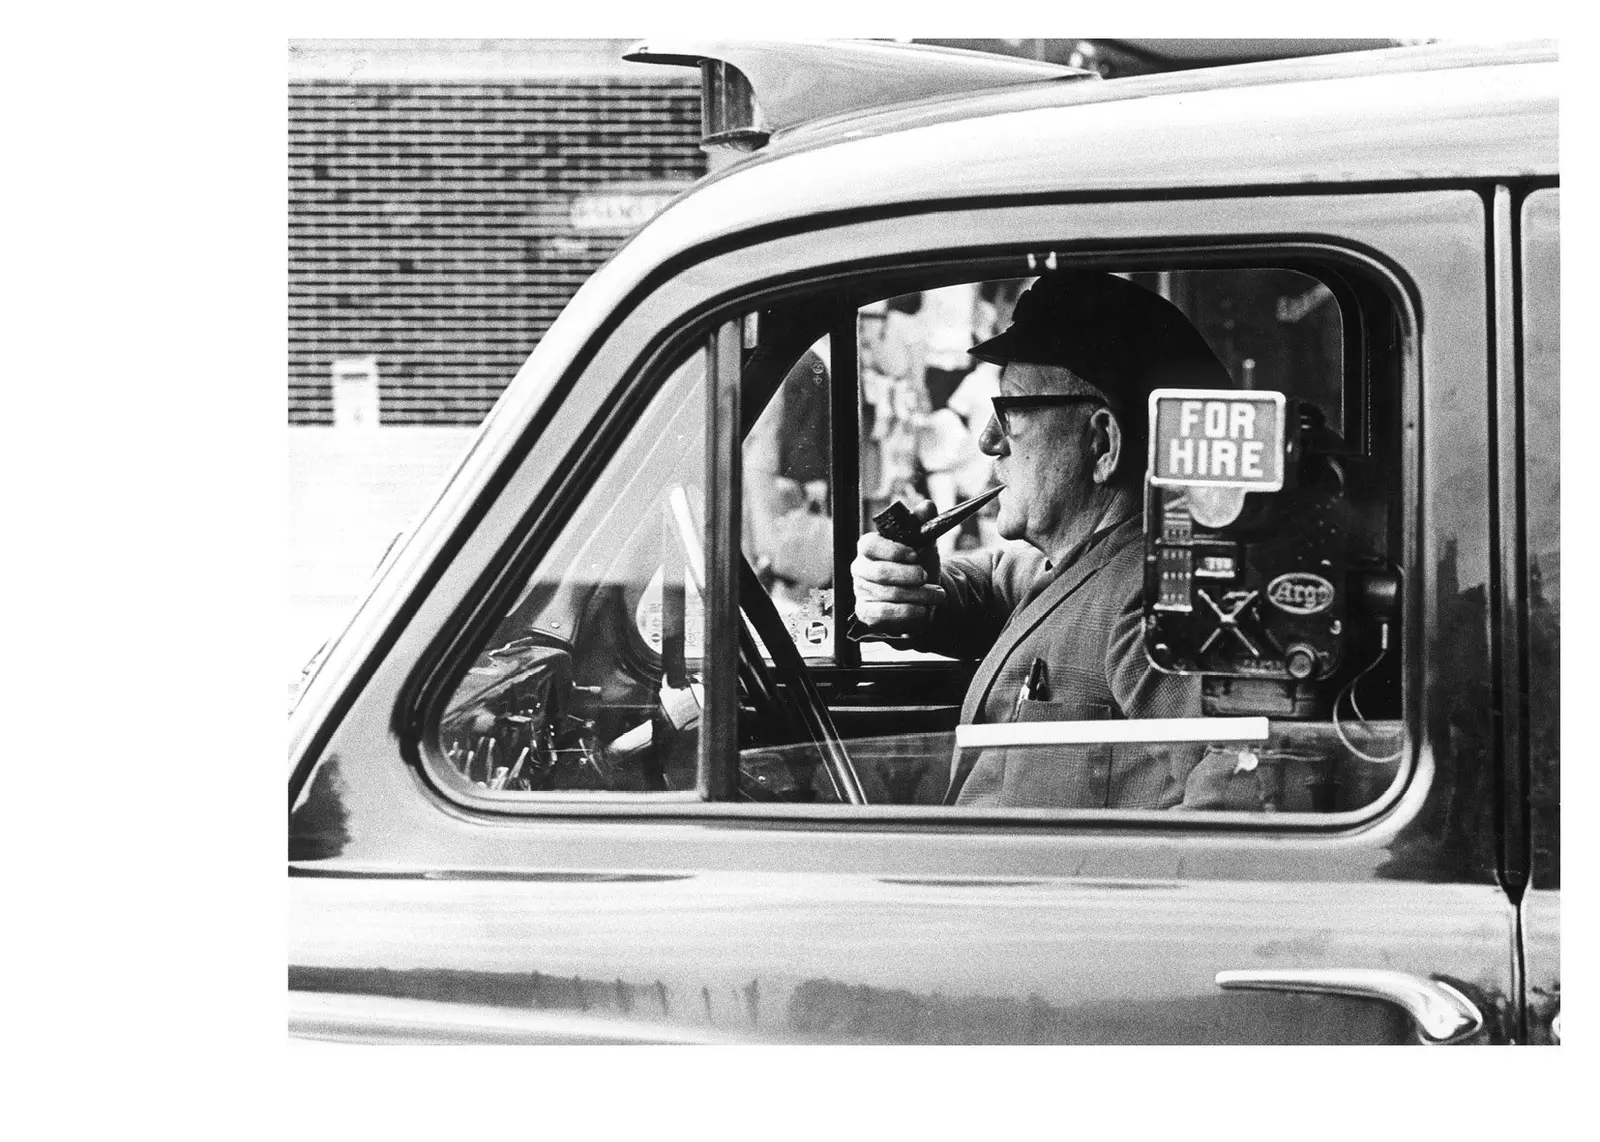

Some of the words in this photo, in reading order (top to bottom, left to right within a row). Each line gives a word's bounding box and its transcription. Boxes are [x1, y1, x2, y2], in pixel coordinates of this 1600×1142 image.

[1180, 401, 1256, 440] FOR
[1168, 438, 1265, 478] HIRE
[1275, 581, 1331, 610] Argo
